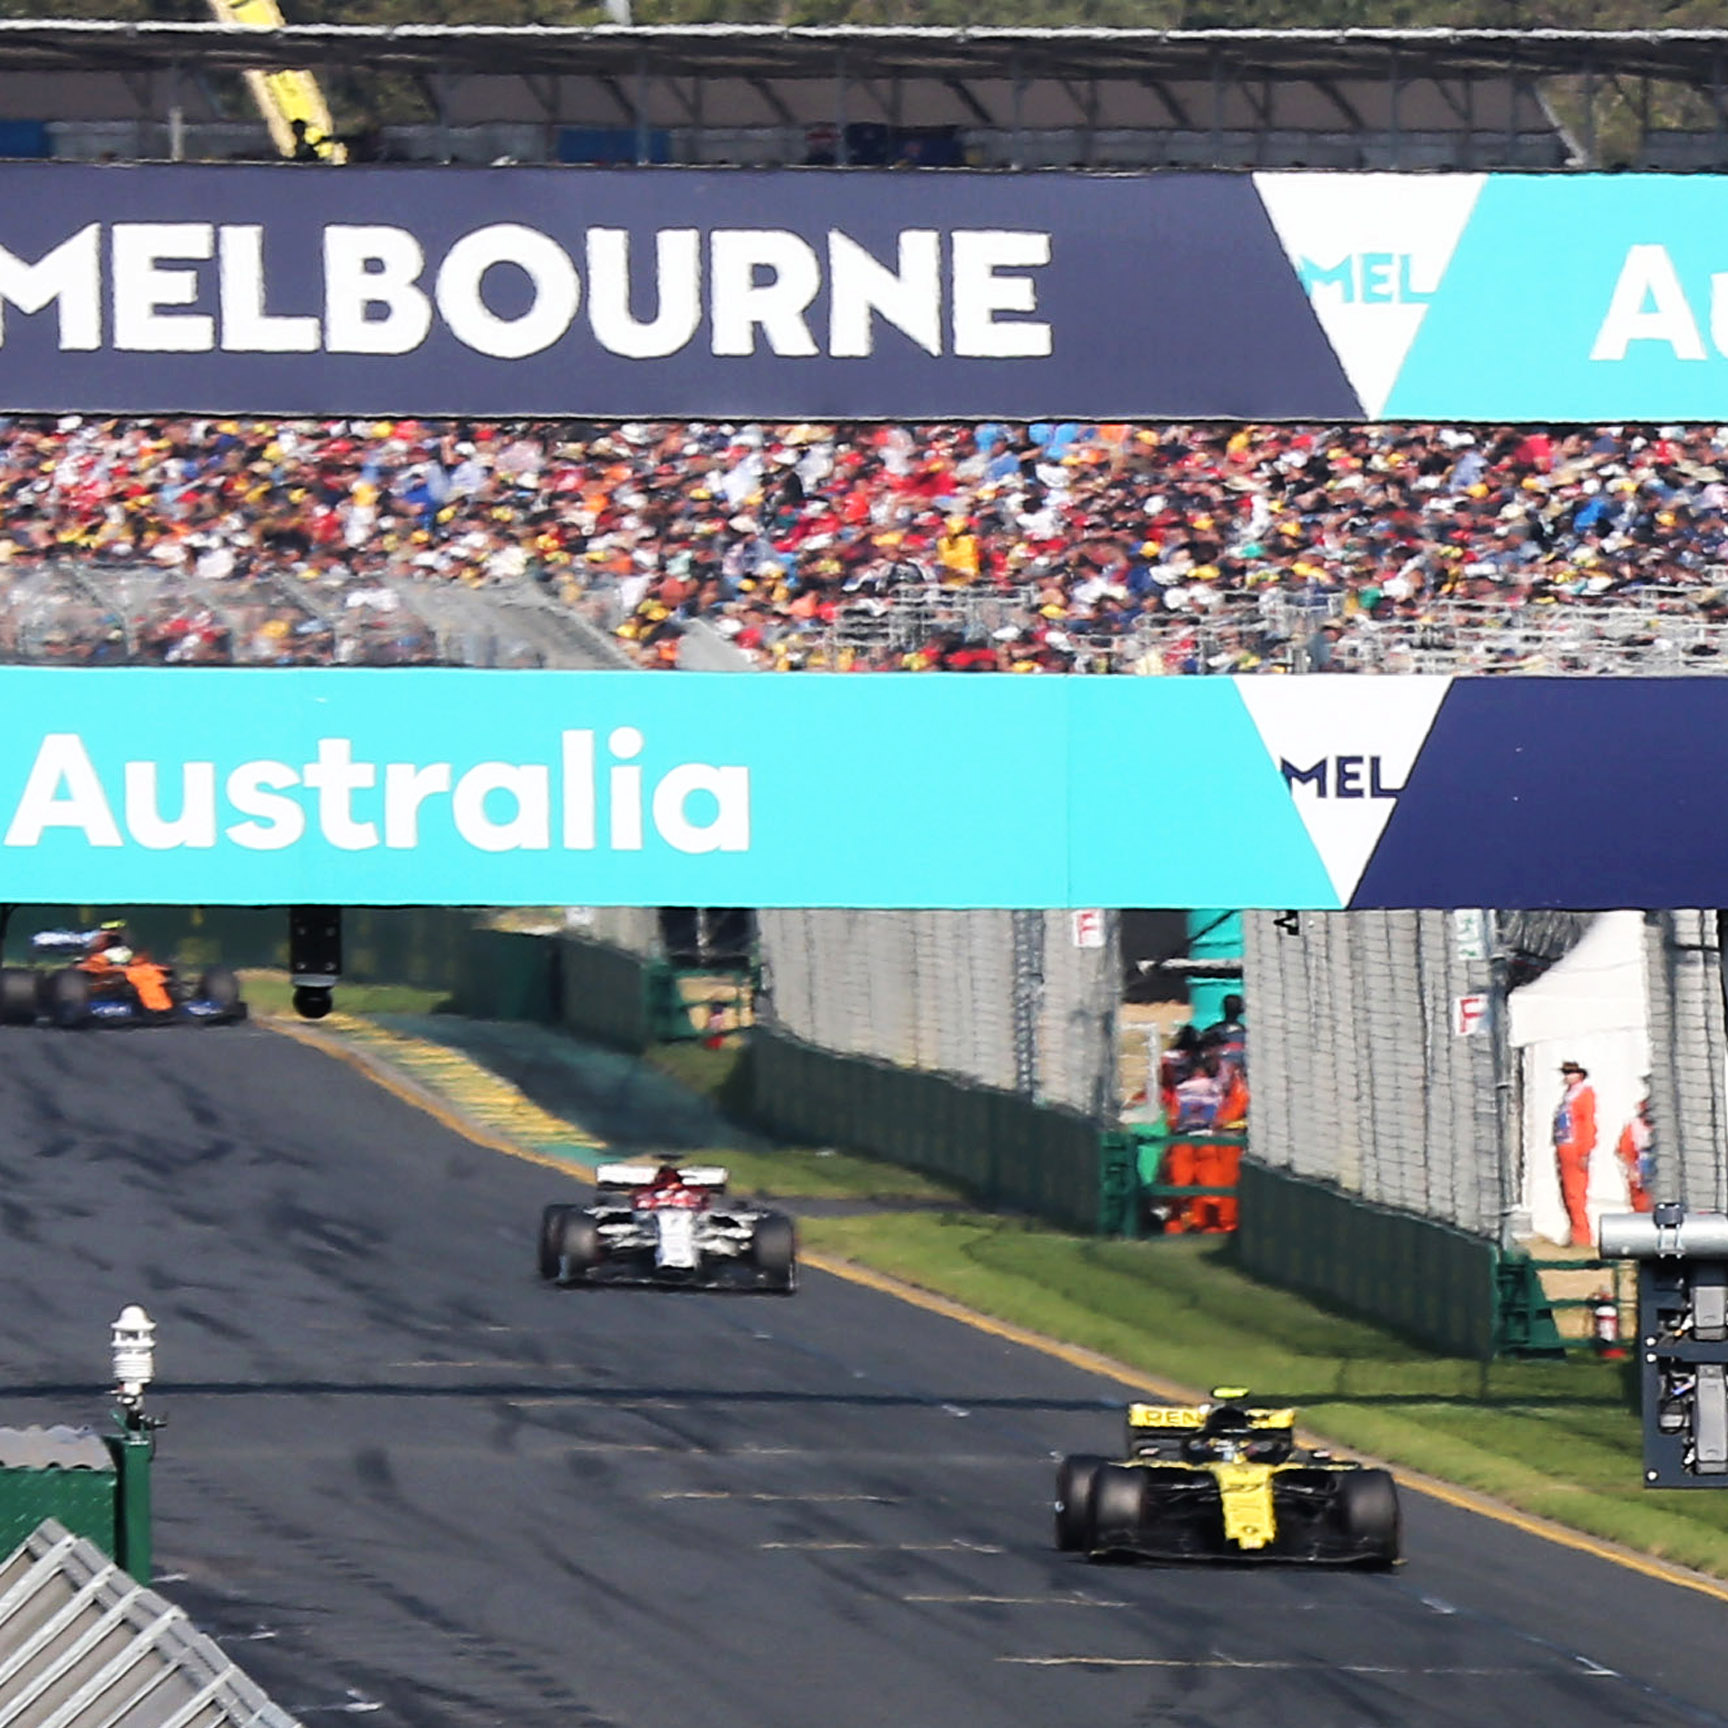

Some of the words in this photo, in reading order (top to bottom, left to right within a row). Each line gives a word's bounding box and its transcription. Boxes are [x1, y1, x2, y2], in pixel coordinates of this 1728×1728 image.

[0, 222, 1052, 360] MELBOURNE
[1299, 252, 1431, 305] MEL
[4, 726, 751, 854] Australia
[1280, 754, 1399, 800] MEL
[1077, 912, 1098, 945] F
[1459, 997, 1485, 1034] F
